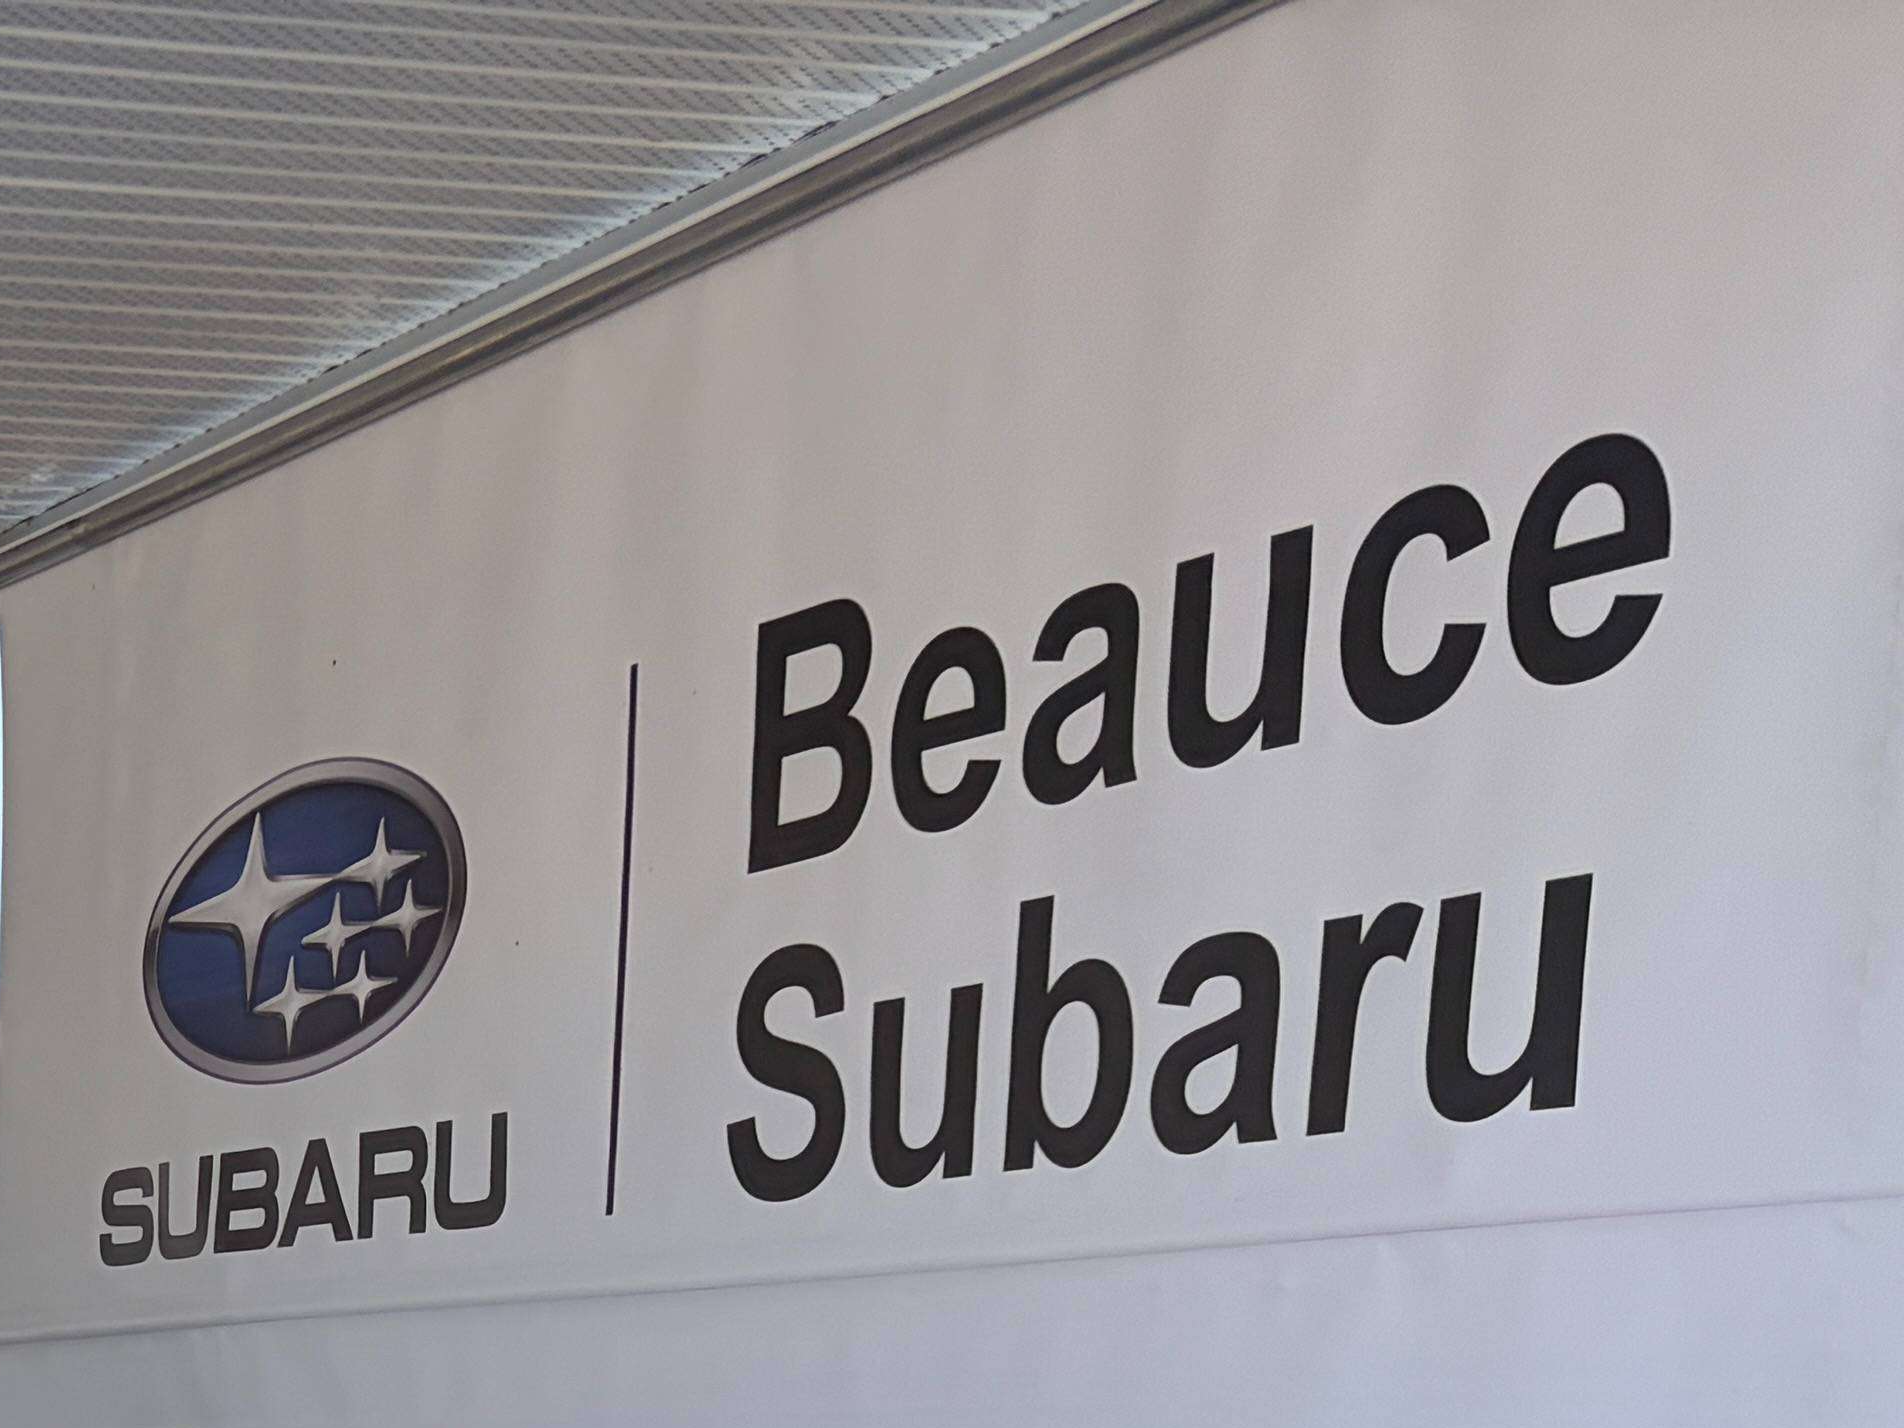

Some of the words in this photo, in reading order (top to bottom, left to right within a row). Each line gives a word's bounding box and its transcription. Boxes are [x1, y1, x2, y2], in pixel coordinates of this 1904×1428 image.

[747, 430, 1673, 873] Beauce
[96, 1110, 508, 1267] SUBARU
[724, 872, 1595, 1202] Subaru
